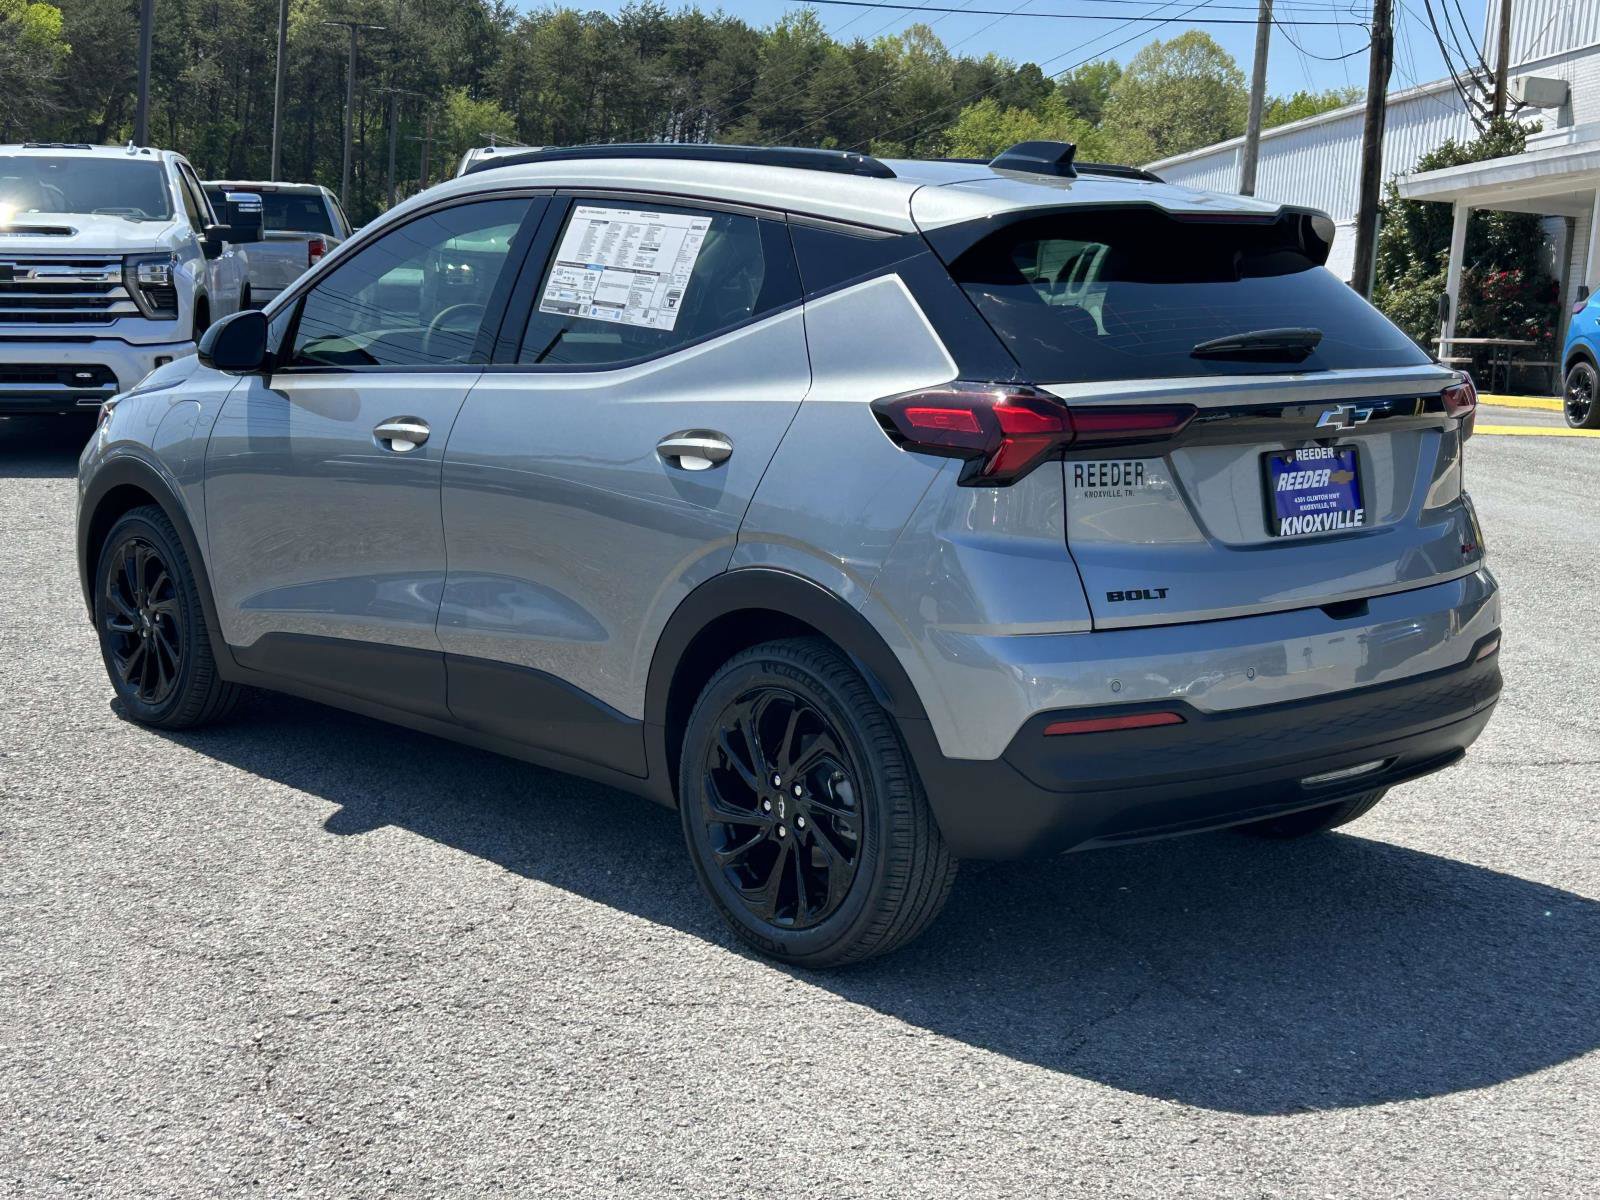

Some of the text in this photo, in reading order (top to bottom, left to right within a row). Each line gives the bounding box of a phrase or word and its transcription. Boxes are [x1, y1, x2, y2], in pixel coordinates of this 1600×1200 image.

[1295, 447, 1335, 461] REEDER
[1074, 461, 1145, 488] REEDER
[1277, 468, 1331, 492] REEDER
[1280, 508, 1364, 536] KNOXVILLE
[1106, 587, 1170, 603] BOLT
